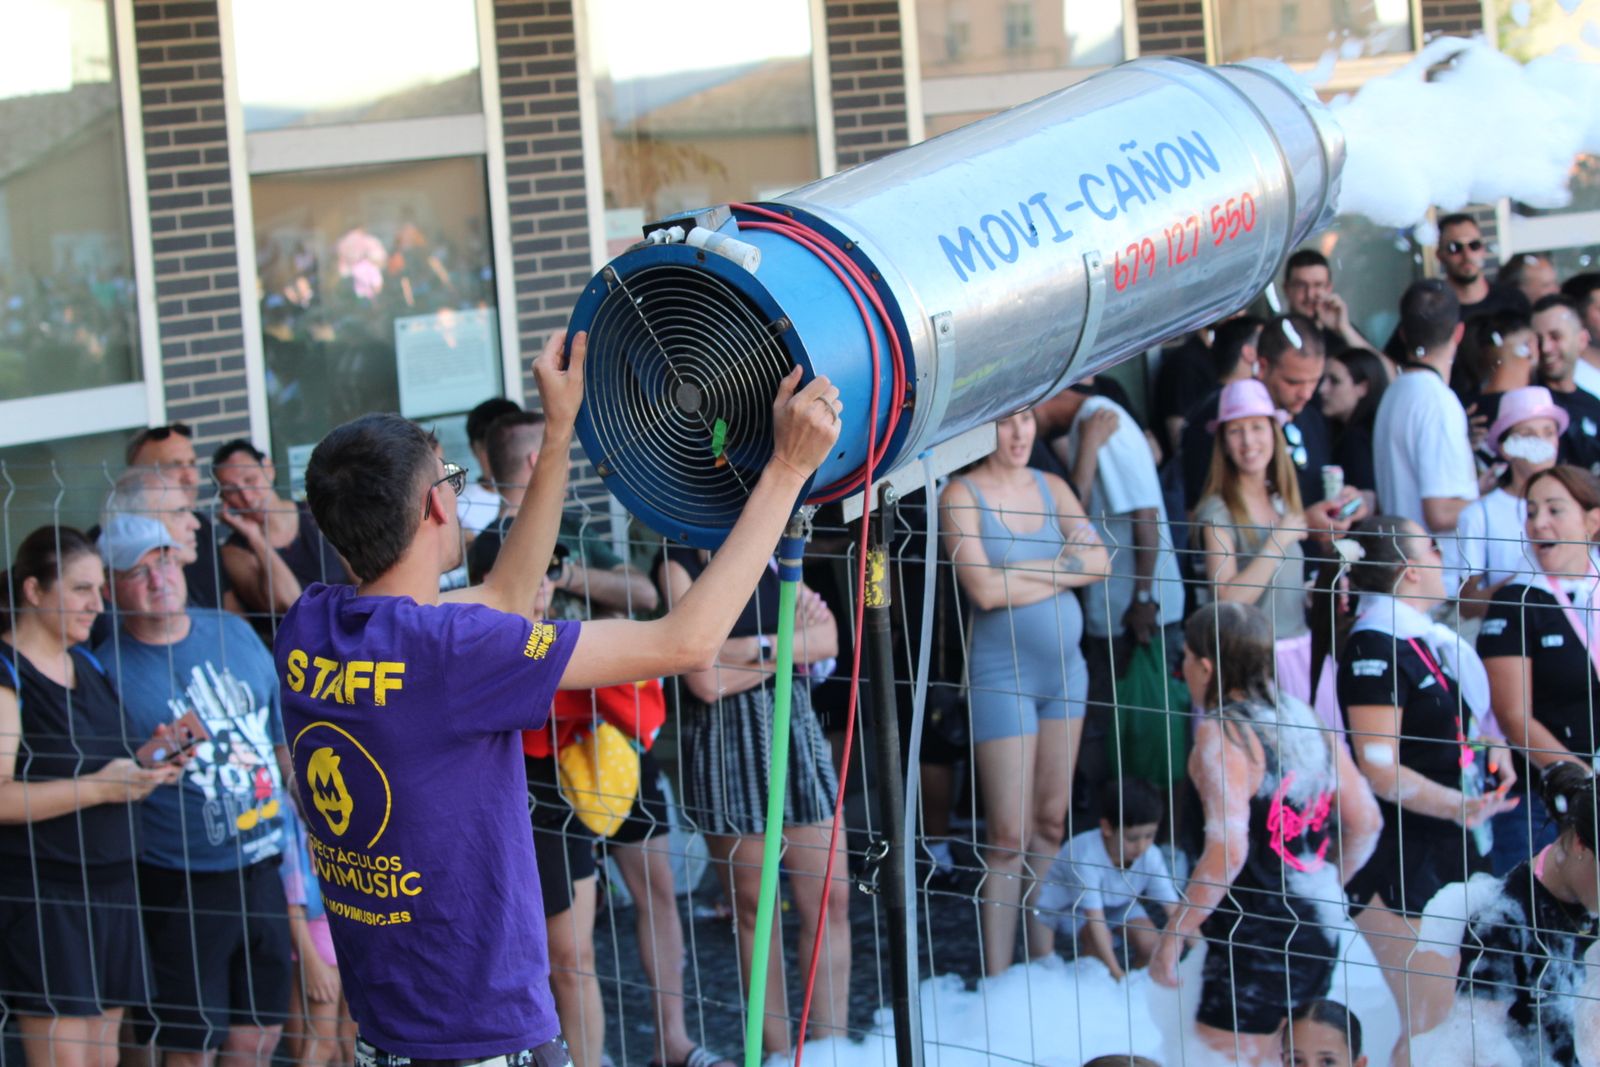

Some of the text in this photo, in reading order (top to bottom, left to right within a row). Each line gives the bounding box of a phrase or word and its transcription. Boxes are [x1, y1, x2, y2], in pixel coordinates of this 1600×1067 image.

[937, 130, 1221, 282] MOVI-CAÑON
[1114, 192, 1256, 292] 679 127 550
[286, 649, 406, 707] STAFF
[316, 858, 422, 898] VIMUSIC
